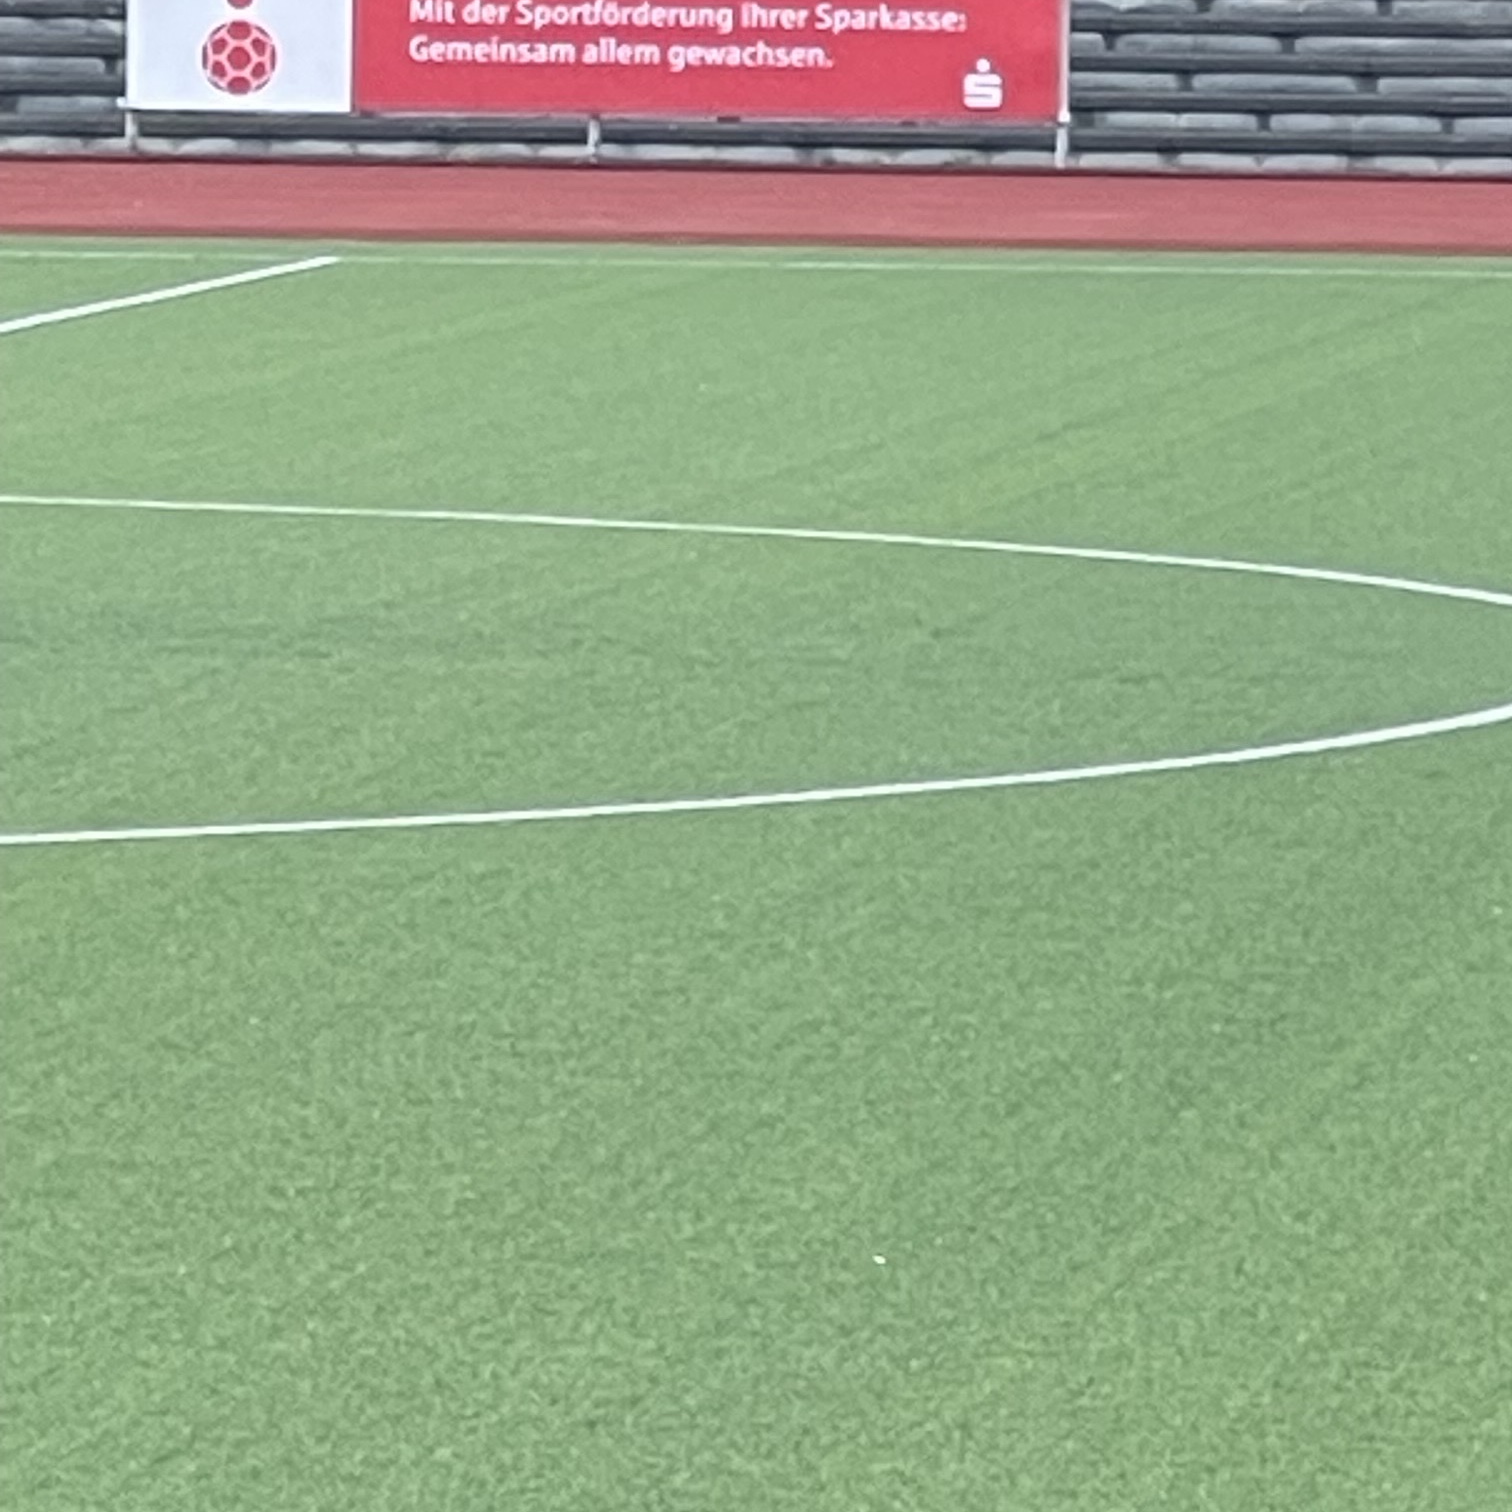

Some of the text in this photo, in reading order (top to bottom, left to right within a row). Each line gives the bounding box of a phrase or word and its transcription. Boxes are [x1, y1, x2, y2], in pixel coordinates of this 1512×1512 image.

[514, 0, 733, 35] Sportförderung
[740, 2, 809, 30] Ihrer
[814, 3, 967, 35] Sparkasse:
[408, 34, 834, 73] Gemeinsam allem gewachsen.
